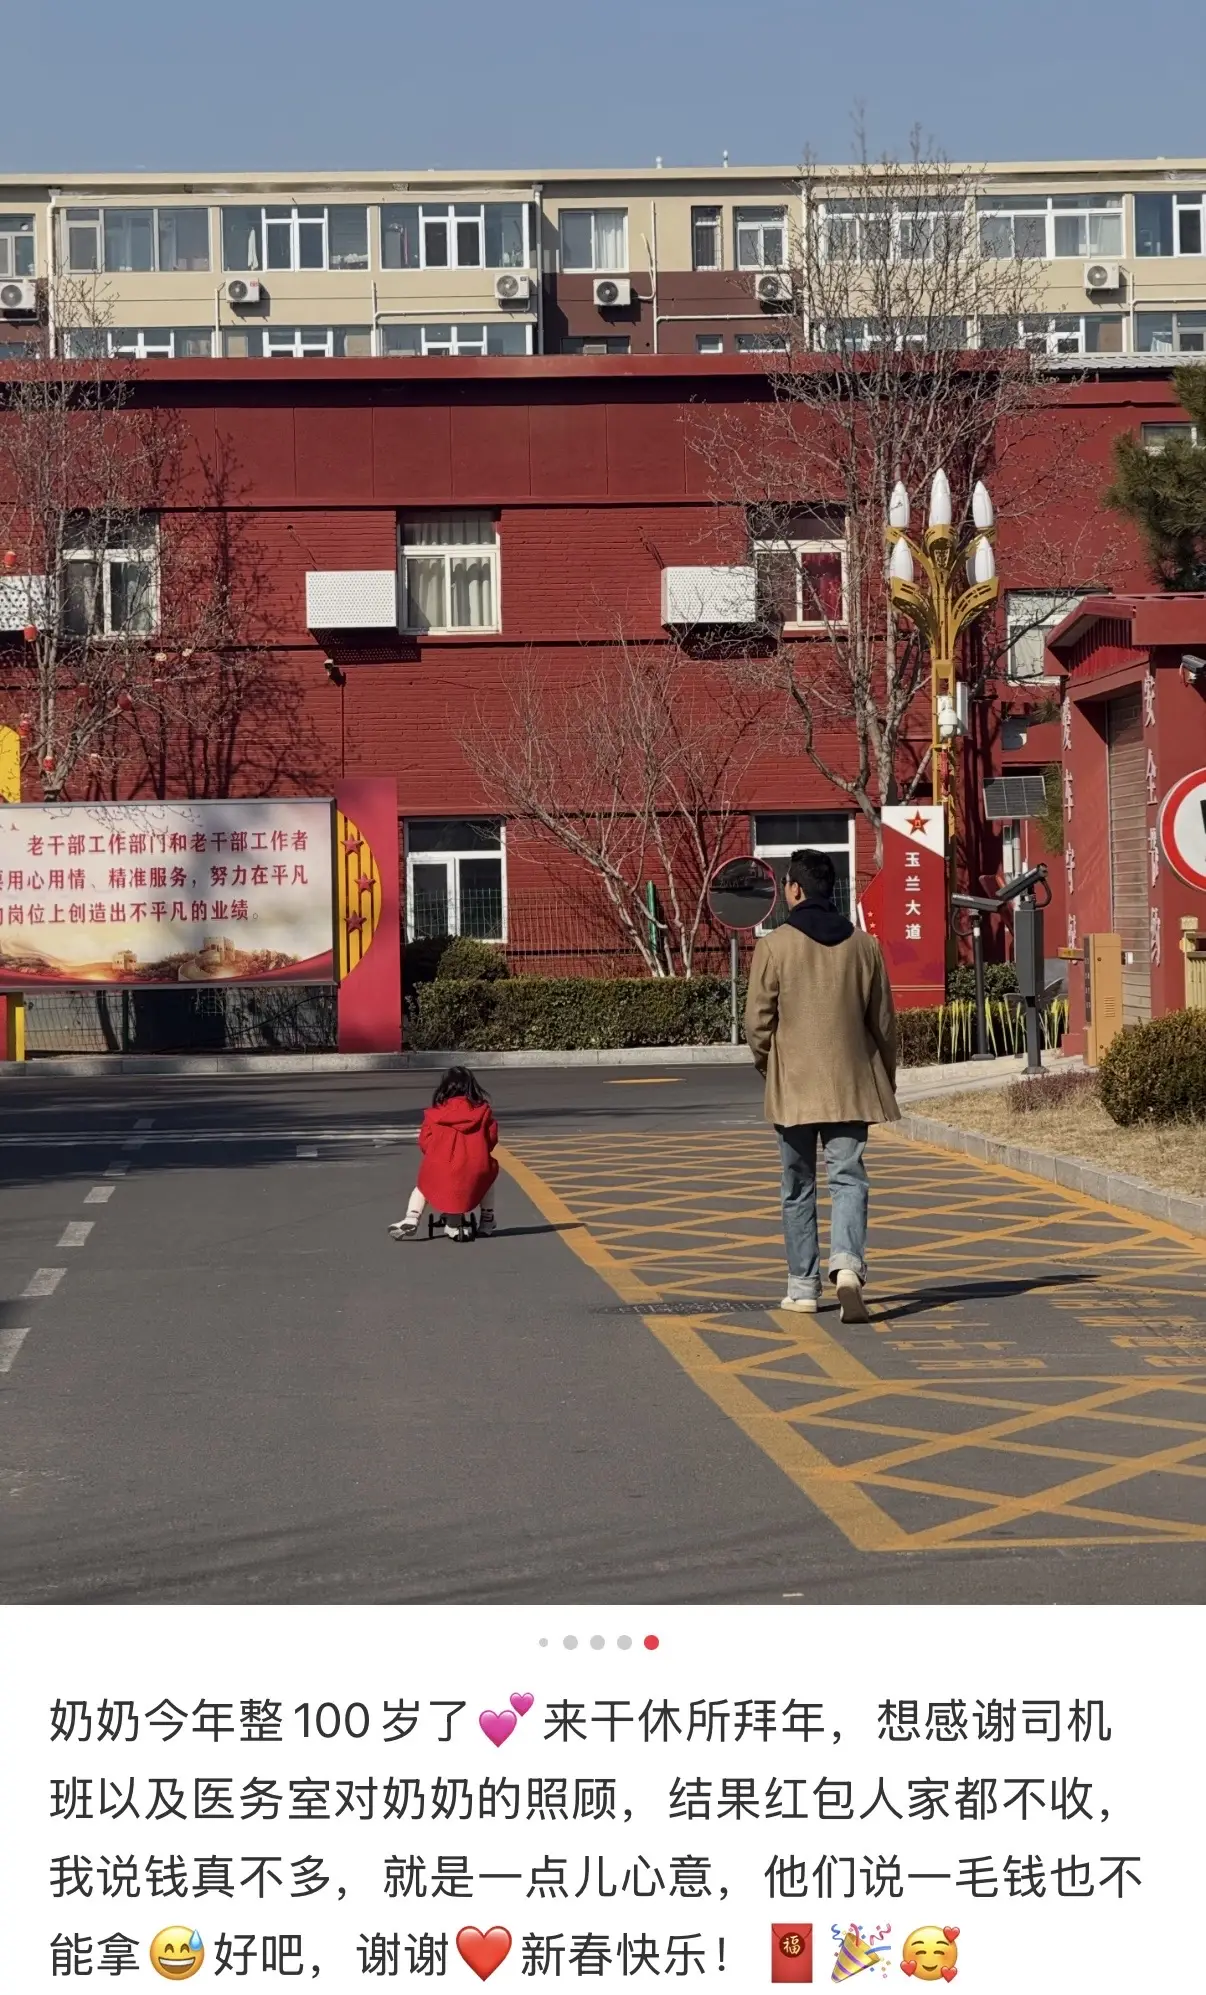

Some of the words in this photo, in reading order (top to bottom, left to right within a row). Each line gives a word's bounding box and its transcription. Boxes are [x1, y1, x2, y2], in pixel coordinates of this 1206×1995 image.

[27, 831, 308, 856] 老干部工作部门和老干部工作者
[0, 864, 309, 892] 用心用情、精准服务，努力在平凡
[904, 851, 922, 940] 玉兰大道
[0, 899, 260, 924] 岗位上创造出不平凡的业绩。
